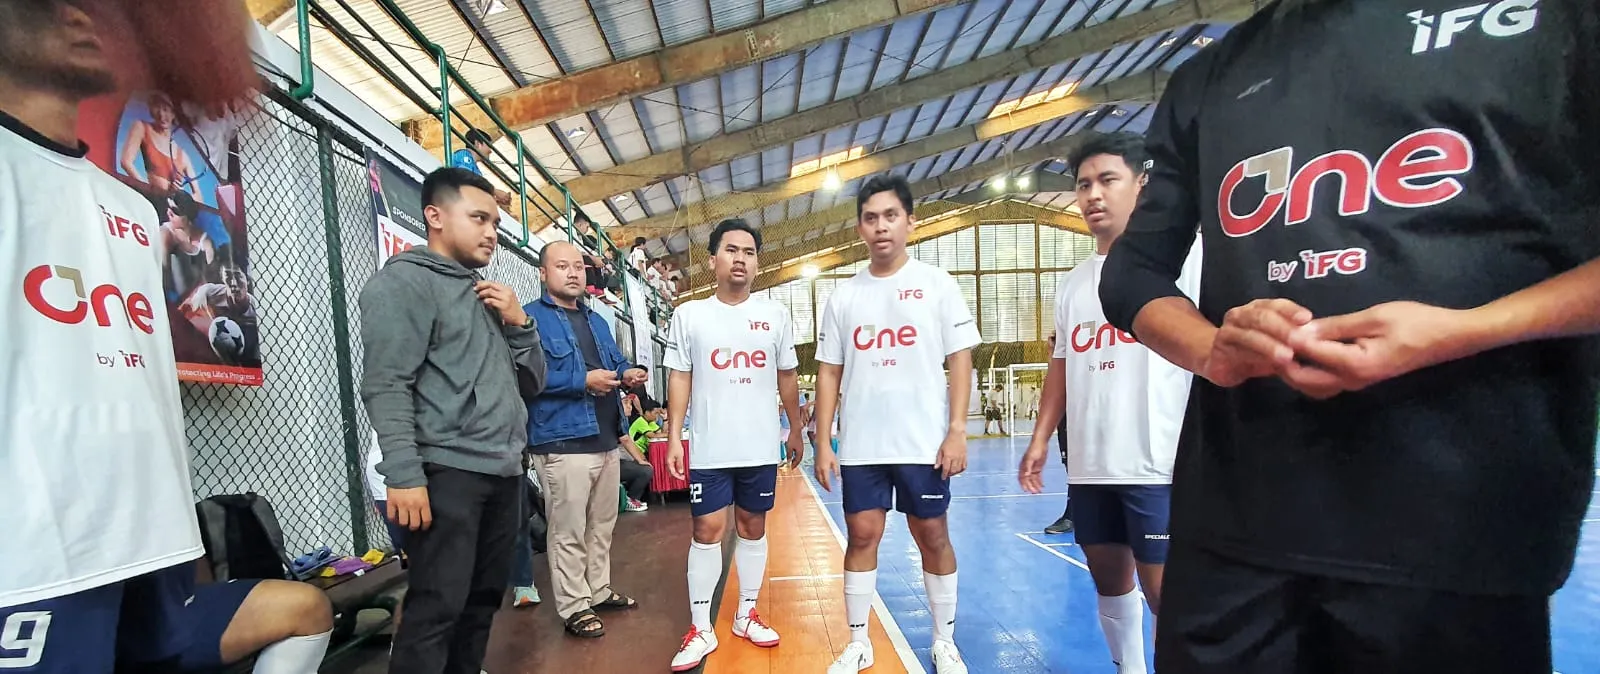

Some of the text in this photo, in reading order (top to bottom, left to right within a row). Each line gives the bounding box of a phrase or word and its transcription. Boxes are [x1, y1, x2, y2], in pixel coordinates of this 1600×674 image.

[1218, 128, 1473, 237] One
[392, 206, 426, 231] SPONSORED
[1268, 260, 1298, 282] by
[23, 264, 155, 335] One
[853, 324, 918, 350] One
[96, 352, 115, 368] by
[710, 347, 767, 370] One
[176, 368, 211, 378] rotecting
[229, 372, 256, 381] Progress
[0, 610, 53, 668] 9
